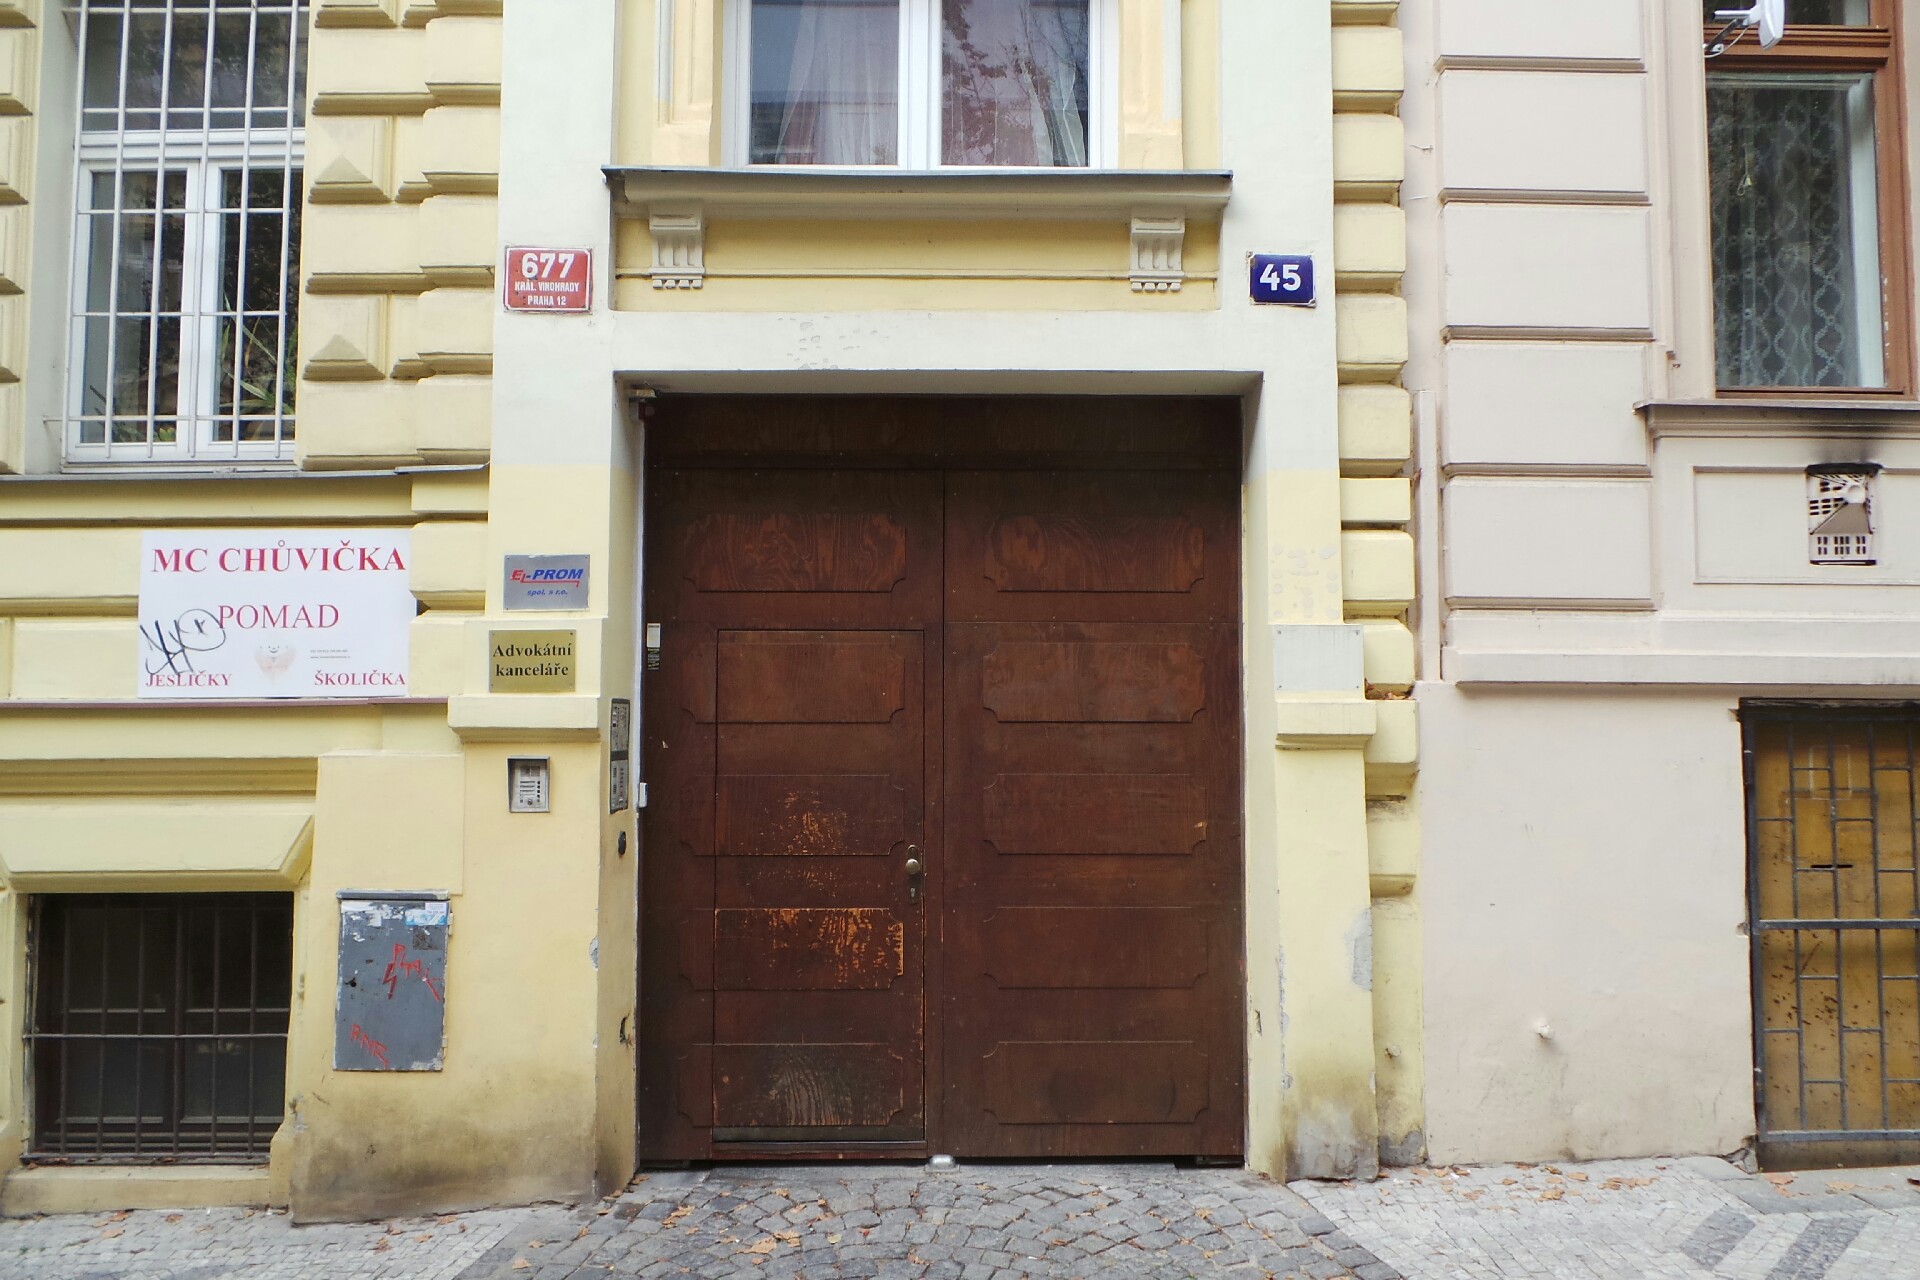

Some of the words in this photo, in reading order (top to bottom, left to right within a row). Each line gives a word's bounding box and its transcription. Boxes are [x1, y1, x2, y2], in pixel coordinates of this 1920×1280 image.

[521, 252, 575, 278] 677
[1259, 263, 1302, 292] 45
[514, 279, 537, 292] KRÁL.
[538, 281, 580, 293] VINOHRADY
[527, 294, 554, 306] PRAHA
[556, 295, 567, 306] 12
[152, 547, 208, 573] MC
[218, 539, 406, 573] CHŮVIČKA
[527, 588, 546, 597] spol.
[218, 604, 340, 630] POMAD
[493, 642, 573, 658] Advokátní
[314, 669, 406, 686] ŠKOLIČKA
[495, 663, 569, 677] kanceláře
[146, 671, 233, 687] JESLIČKY
